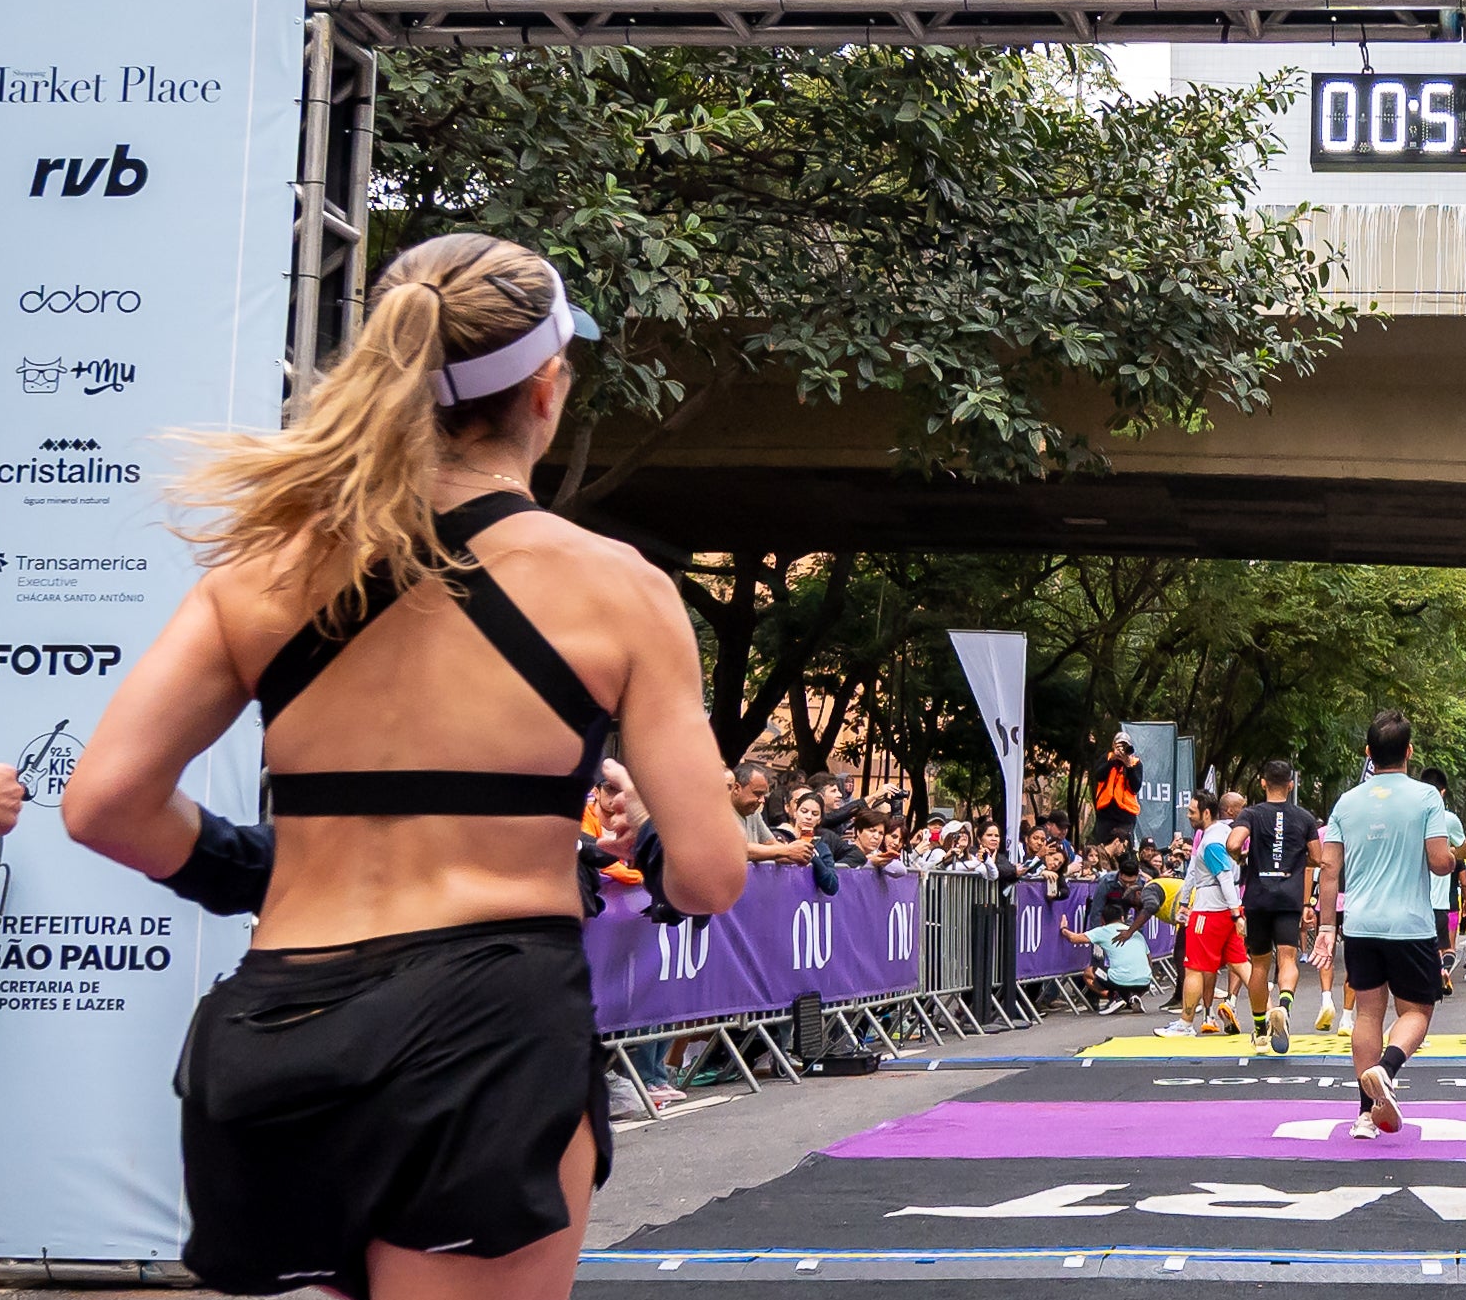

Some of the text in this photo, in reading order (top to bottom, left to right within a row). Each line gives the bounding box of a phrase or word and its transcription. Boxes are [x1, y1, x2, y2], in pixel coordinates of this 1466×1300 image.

[117, 65, 223, 103] Place
[29, 144, 149, 197] rvb
[19, 284, 142, 314] dobro
[16, 555, 148, 571] Transamerica
[17, 576, 79, 588] Executive
[16, 591, 145, 603] CHÁCARA SANTO ANTÔNIO
[50, 747, 72, 758] 92.5
[49, 758, 76, 775] KIS
[140, 916, 172, 935] DE
[60, 944, 172, 971] PAULO
[79, 981, 100, 994] DE
[62, 999, 71, 1011] E
[76, 999, 126, 1011] LAZER
